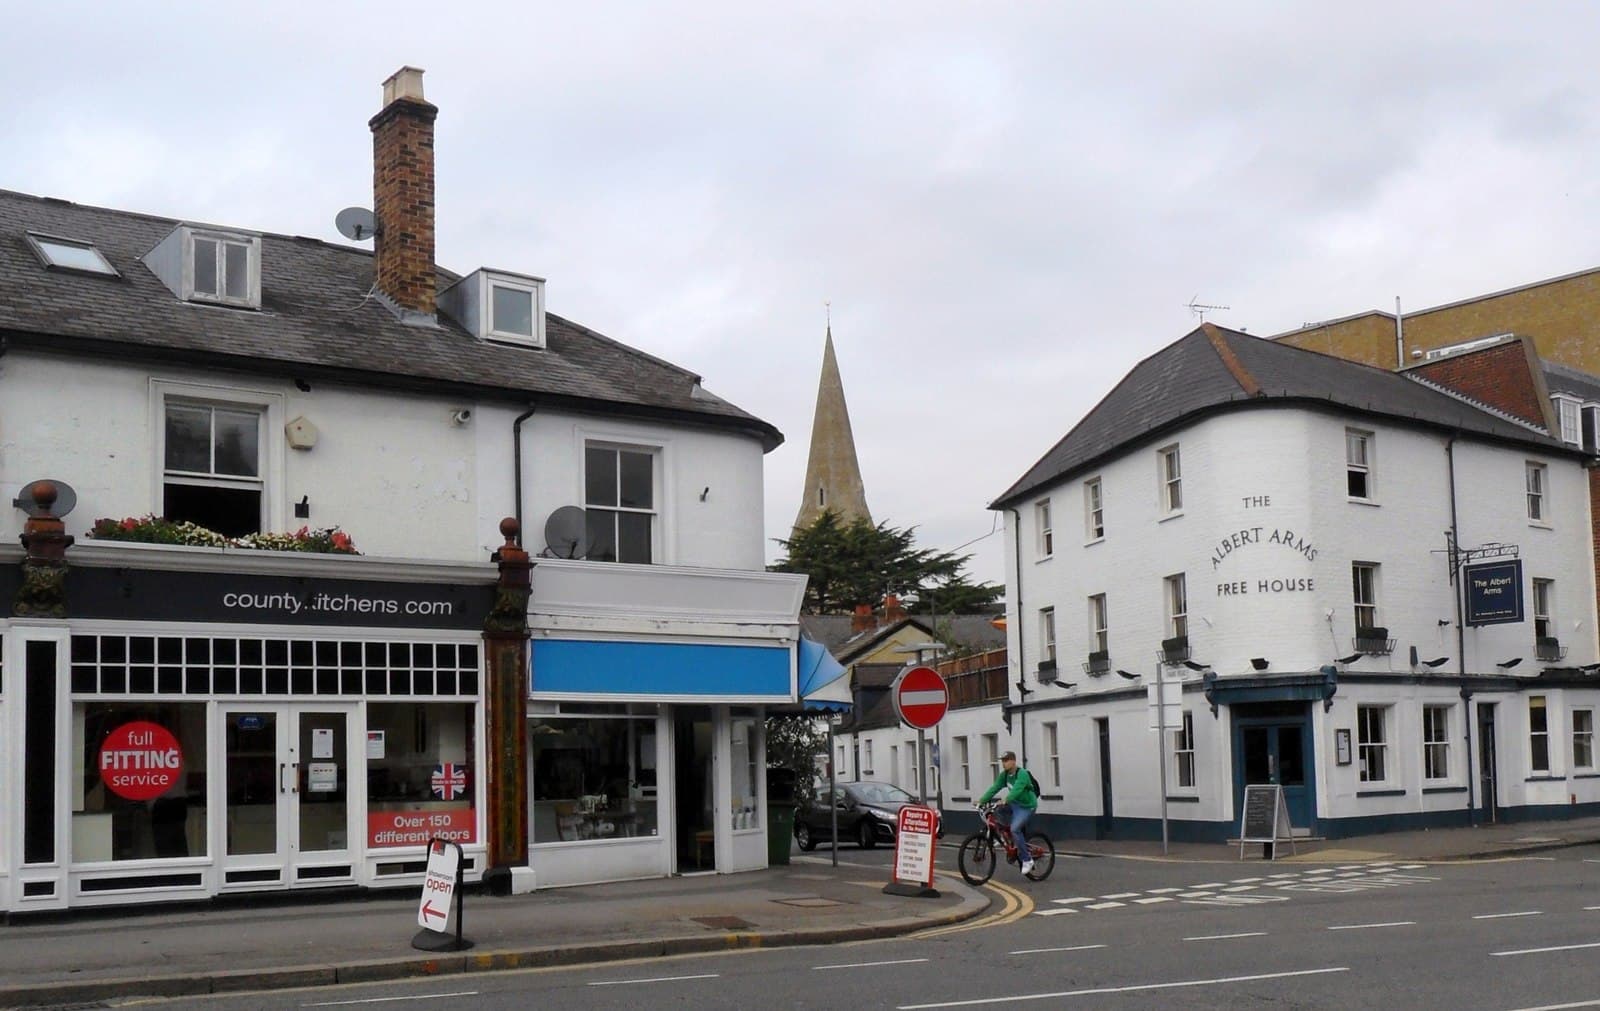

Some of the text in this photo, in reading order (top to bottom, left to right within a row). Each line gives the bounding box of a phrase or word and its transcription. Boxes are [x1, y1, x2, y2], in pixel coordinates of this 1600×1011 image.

[1242, 495, 1271, 509] THE
[1210, 527, 1319, 570] ALBERT ARMS
[1217, 578, 1315, 597] FREE HOUSE
[1474, 577, 1512, 588] The Albert
[1483, 587, 1503, 596] Arms
[127, 731, 153, 746] full
[101, 749, 179, 769] FITTING
[112, 772, 169, 786] service
[394, 815, 451, 828] Over 150
[374, 829, 470, 843] different doors
[426, 878, 452, 895] open
